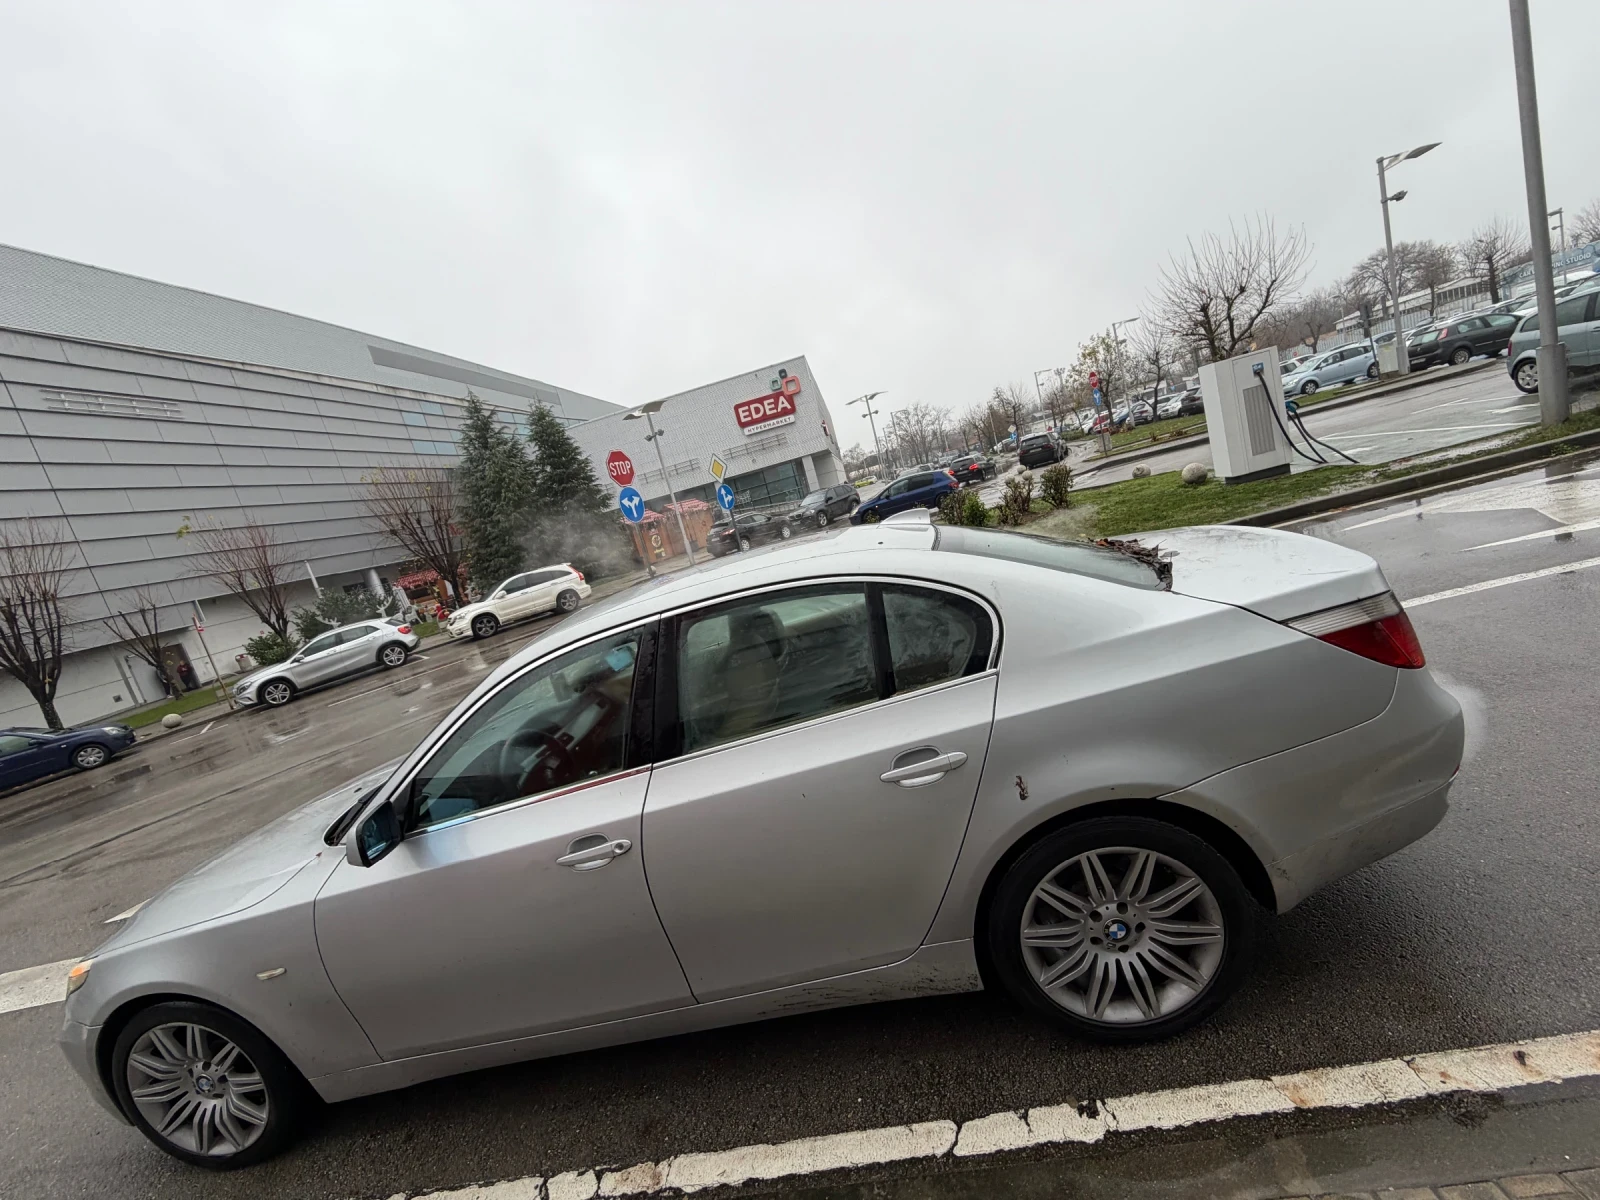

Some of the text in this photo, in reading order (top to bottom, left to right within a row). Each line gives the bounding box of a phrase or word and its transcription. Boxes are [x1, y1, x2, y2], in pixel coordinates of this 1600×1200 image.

[1565, 253, 1592, 265] STUDIO
[738, 396, 791, 422] EDEA
[747, 418, 791, 432] HYPERMARKET
[609, 460, 631, 476] STOP
